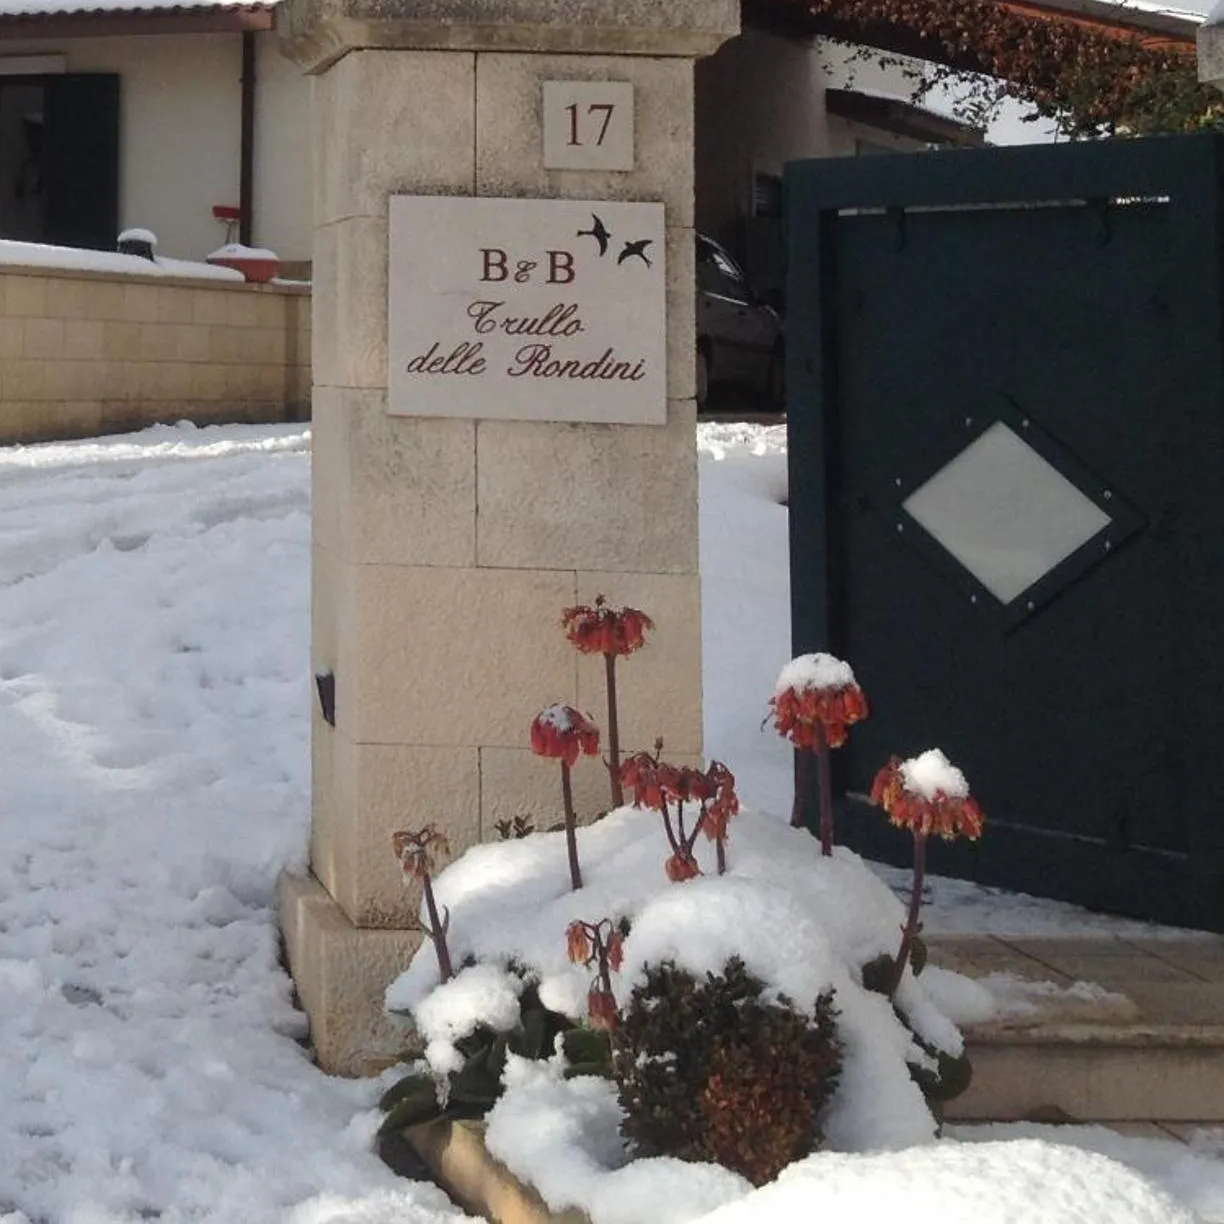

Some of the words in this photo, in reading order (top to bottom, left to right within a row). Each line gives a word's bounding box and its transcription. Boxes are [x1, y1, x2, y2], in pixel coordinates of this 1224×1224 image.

[564, 103, 615, 146] 17
[467, 301, 585, 335] Trullo
[407, 342, 487, 376] delle
[507, 344, 645, 381] Rondini
